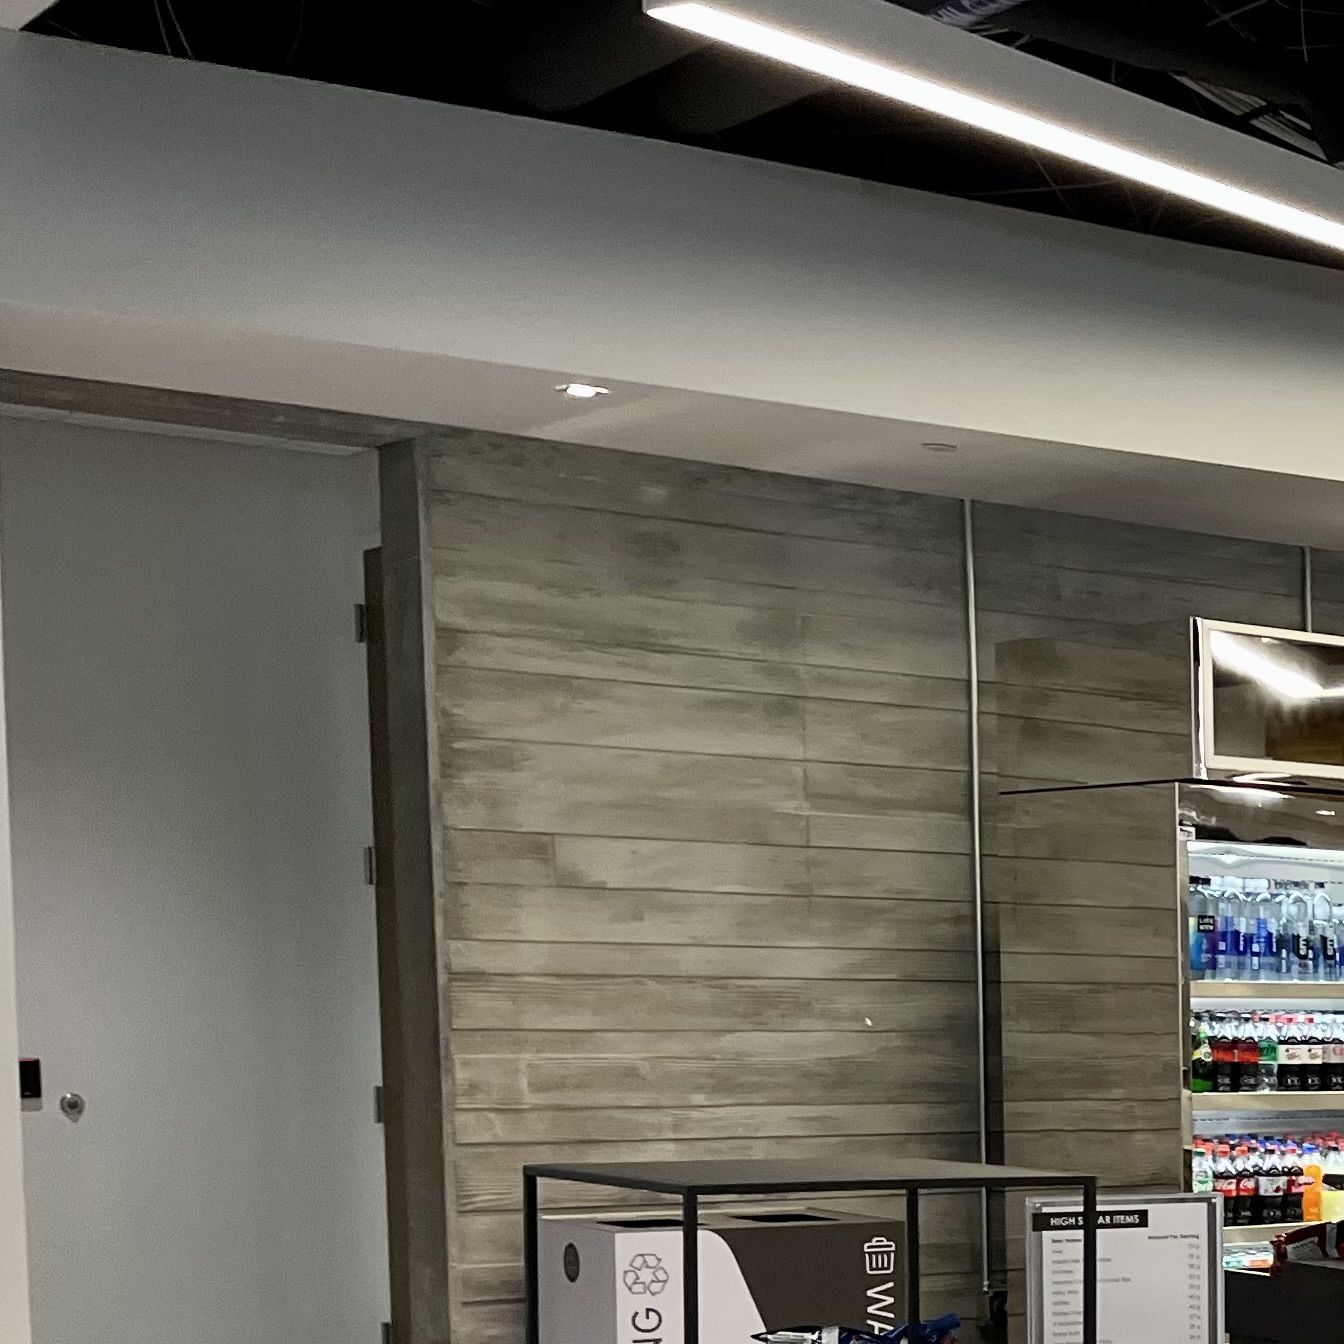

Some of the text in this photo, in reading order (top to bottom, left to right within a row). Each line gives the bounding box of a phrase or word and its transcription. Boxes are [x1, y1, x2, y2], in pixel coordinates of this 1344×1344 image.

[1050, 1214, 1140, 1226] HIGH SAR ITEMS
